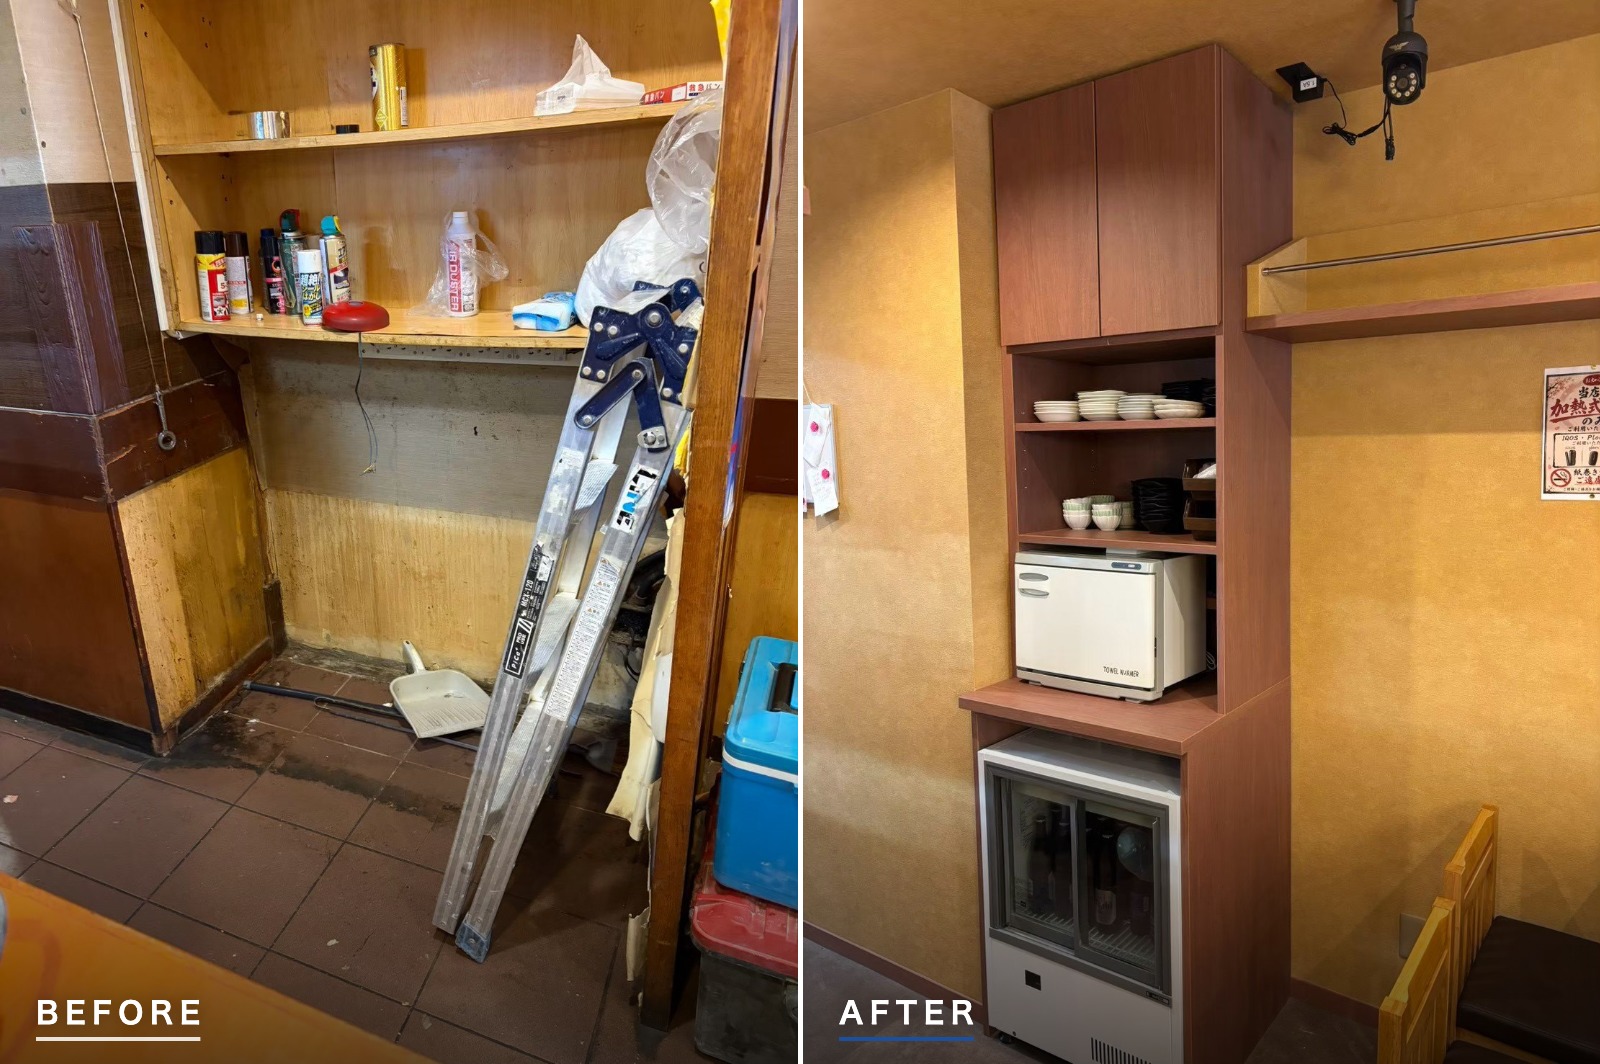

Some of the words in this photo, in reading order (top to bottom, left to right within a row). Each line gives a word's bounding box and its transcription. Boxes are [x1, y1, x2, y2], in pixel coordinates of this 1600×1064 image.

[449, 263, 459, 312] DUSTER
[1579, 386, 1600, 399] 当店
[1550, 398, 1600, 417] 加熱式
[1103, 666, 1119, 675] TOWEL
[1120, 668, 1139, 677] WARMER
